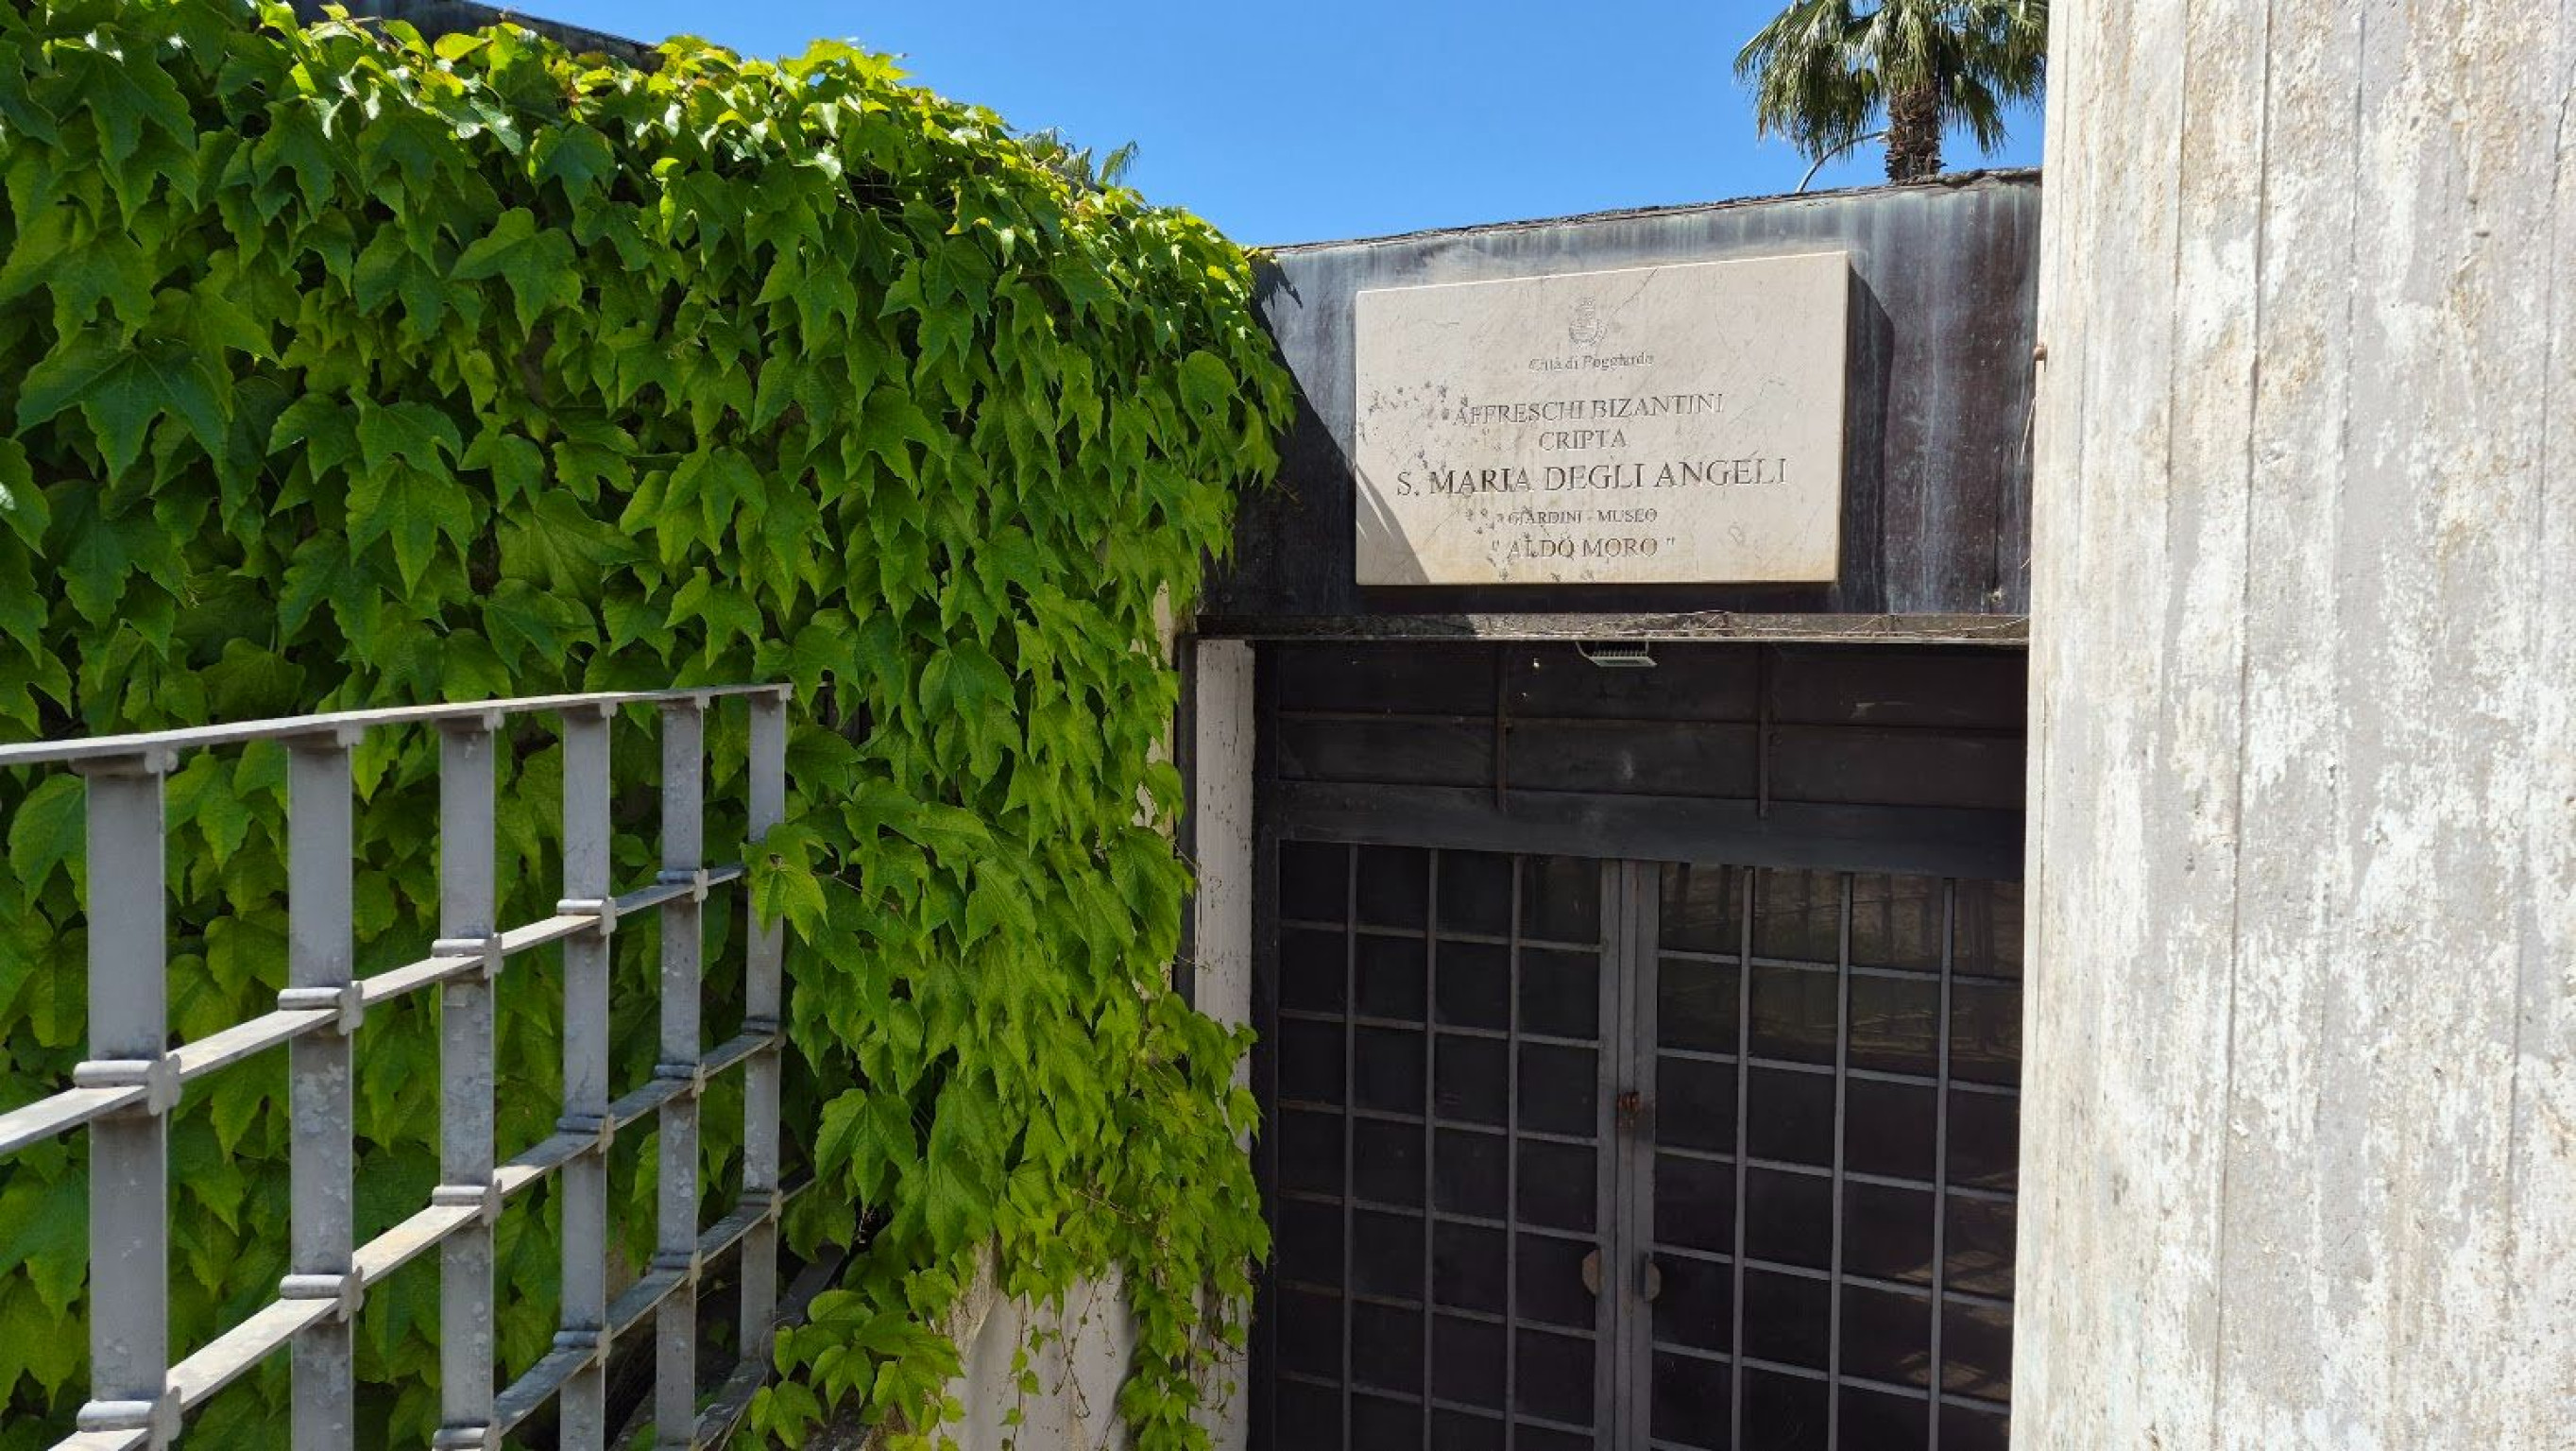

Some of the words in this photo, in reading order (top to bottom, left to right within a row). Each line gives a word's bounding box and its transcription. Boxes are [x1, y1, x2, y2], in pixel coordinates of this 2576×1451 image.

[1565, 355, 1578, 370] di
[1580, 352, 1654, 371] Poggiardo
[1454, 400, 1585, 426] AFFRESCHI
[1591, 393, 1723, 418] BIZANTINI
[1539, 428, 1627, 451] CRIPTA
[1396, 470, 1421, 497] S.
[1429, 467, 1532, 495] MARIA
[1544, 463, 1646, 491] DEGLI
[1653, 458, 1787, 487] ANGELI
[1509, 511, 1582, 525] GIARDINI
[1596, 508, 1658, 523] MUSEO
